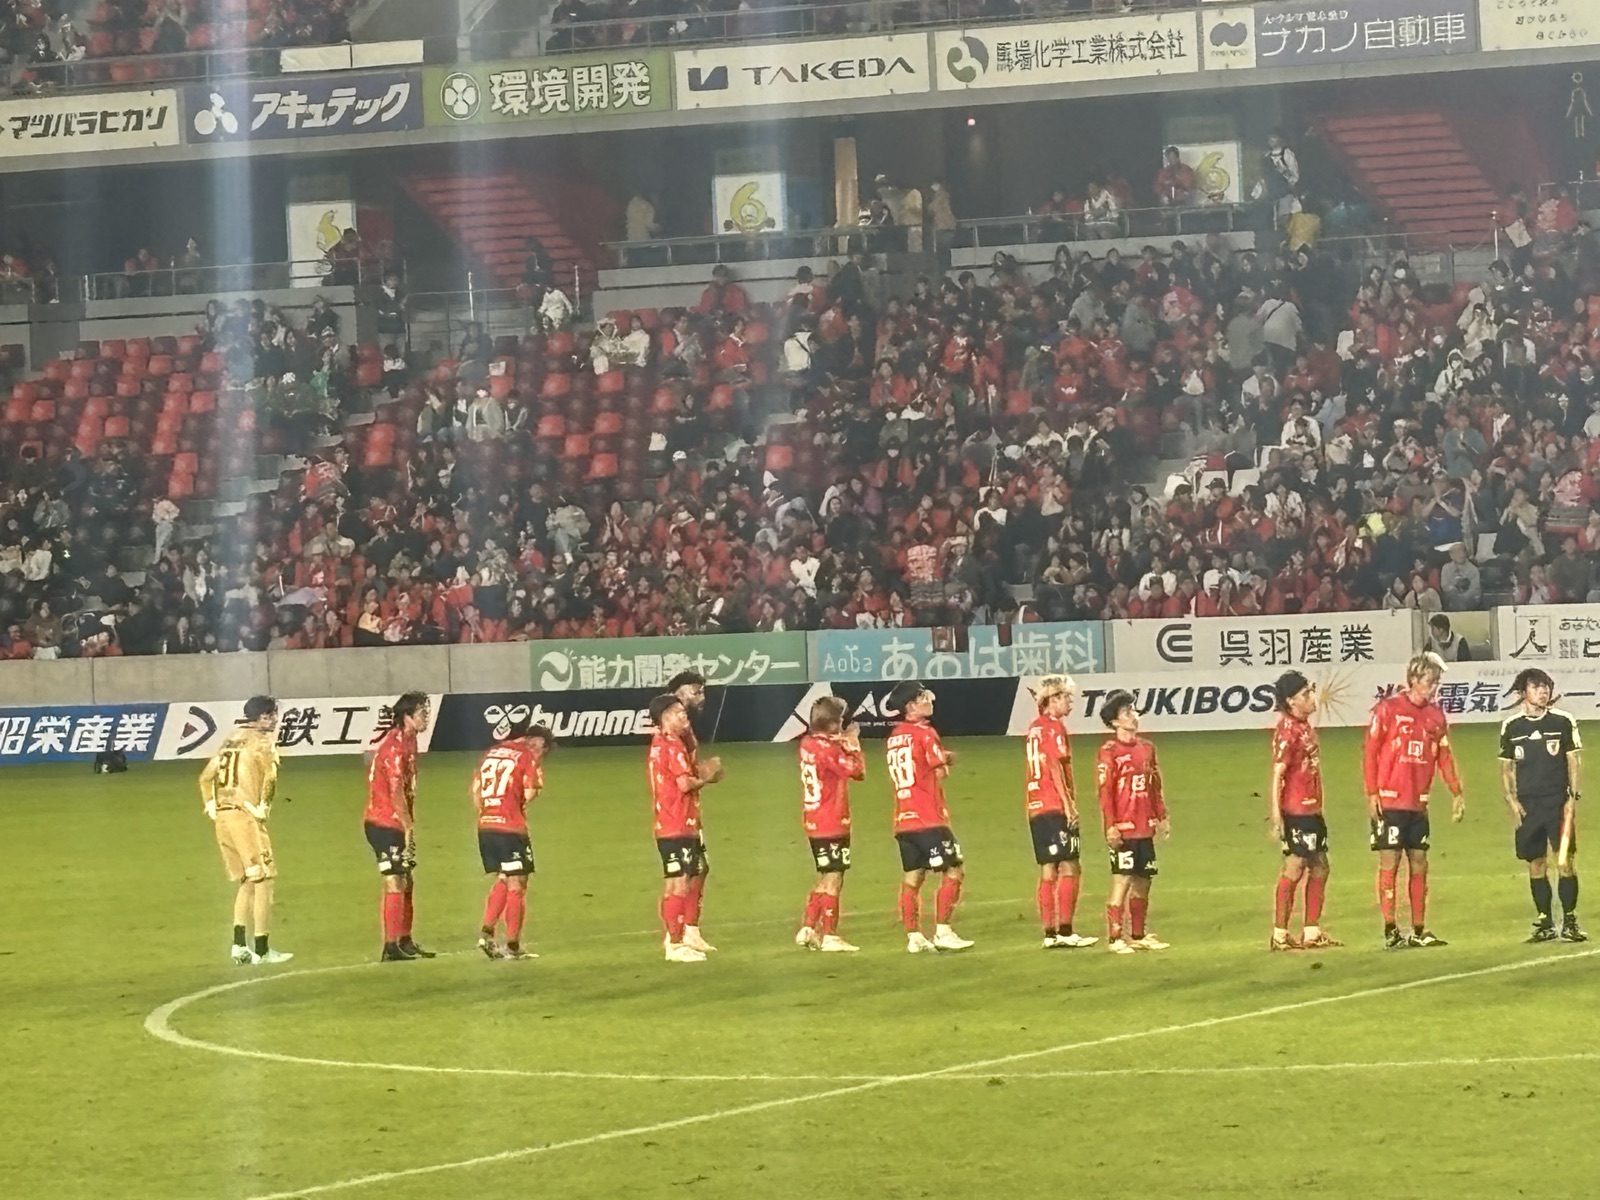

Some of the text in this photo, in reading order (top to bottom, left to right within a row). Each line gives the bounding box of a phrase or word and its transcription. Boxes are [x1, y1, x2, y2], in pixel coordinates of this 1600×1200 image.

[1261, 12, 1467, 57] ナカノ自動車
[488, 61, 652, 117] 環境開発
[741, 56, 917, 86] TAKEDA
[251, 82, 411, 131] アキュテック
[1219, 624, 1375, 666] 呉羽産業
[530, 704, 660, 737] humme
